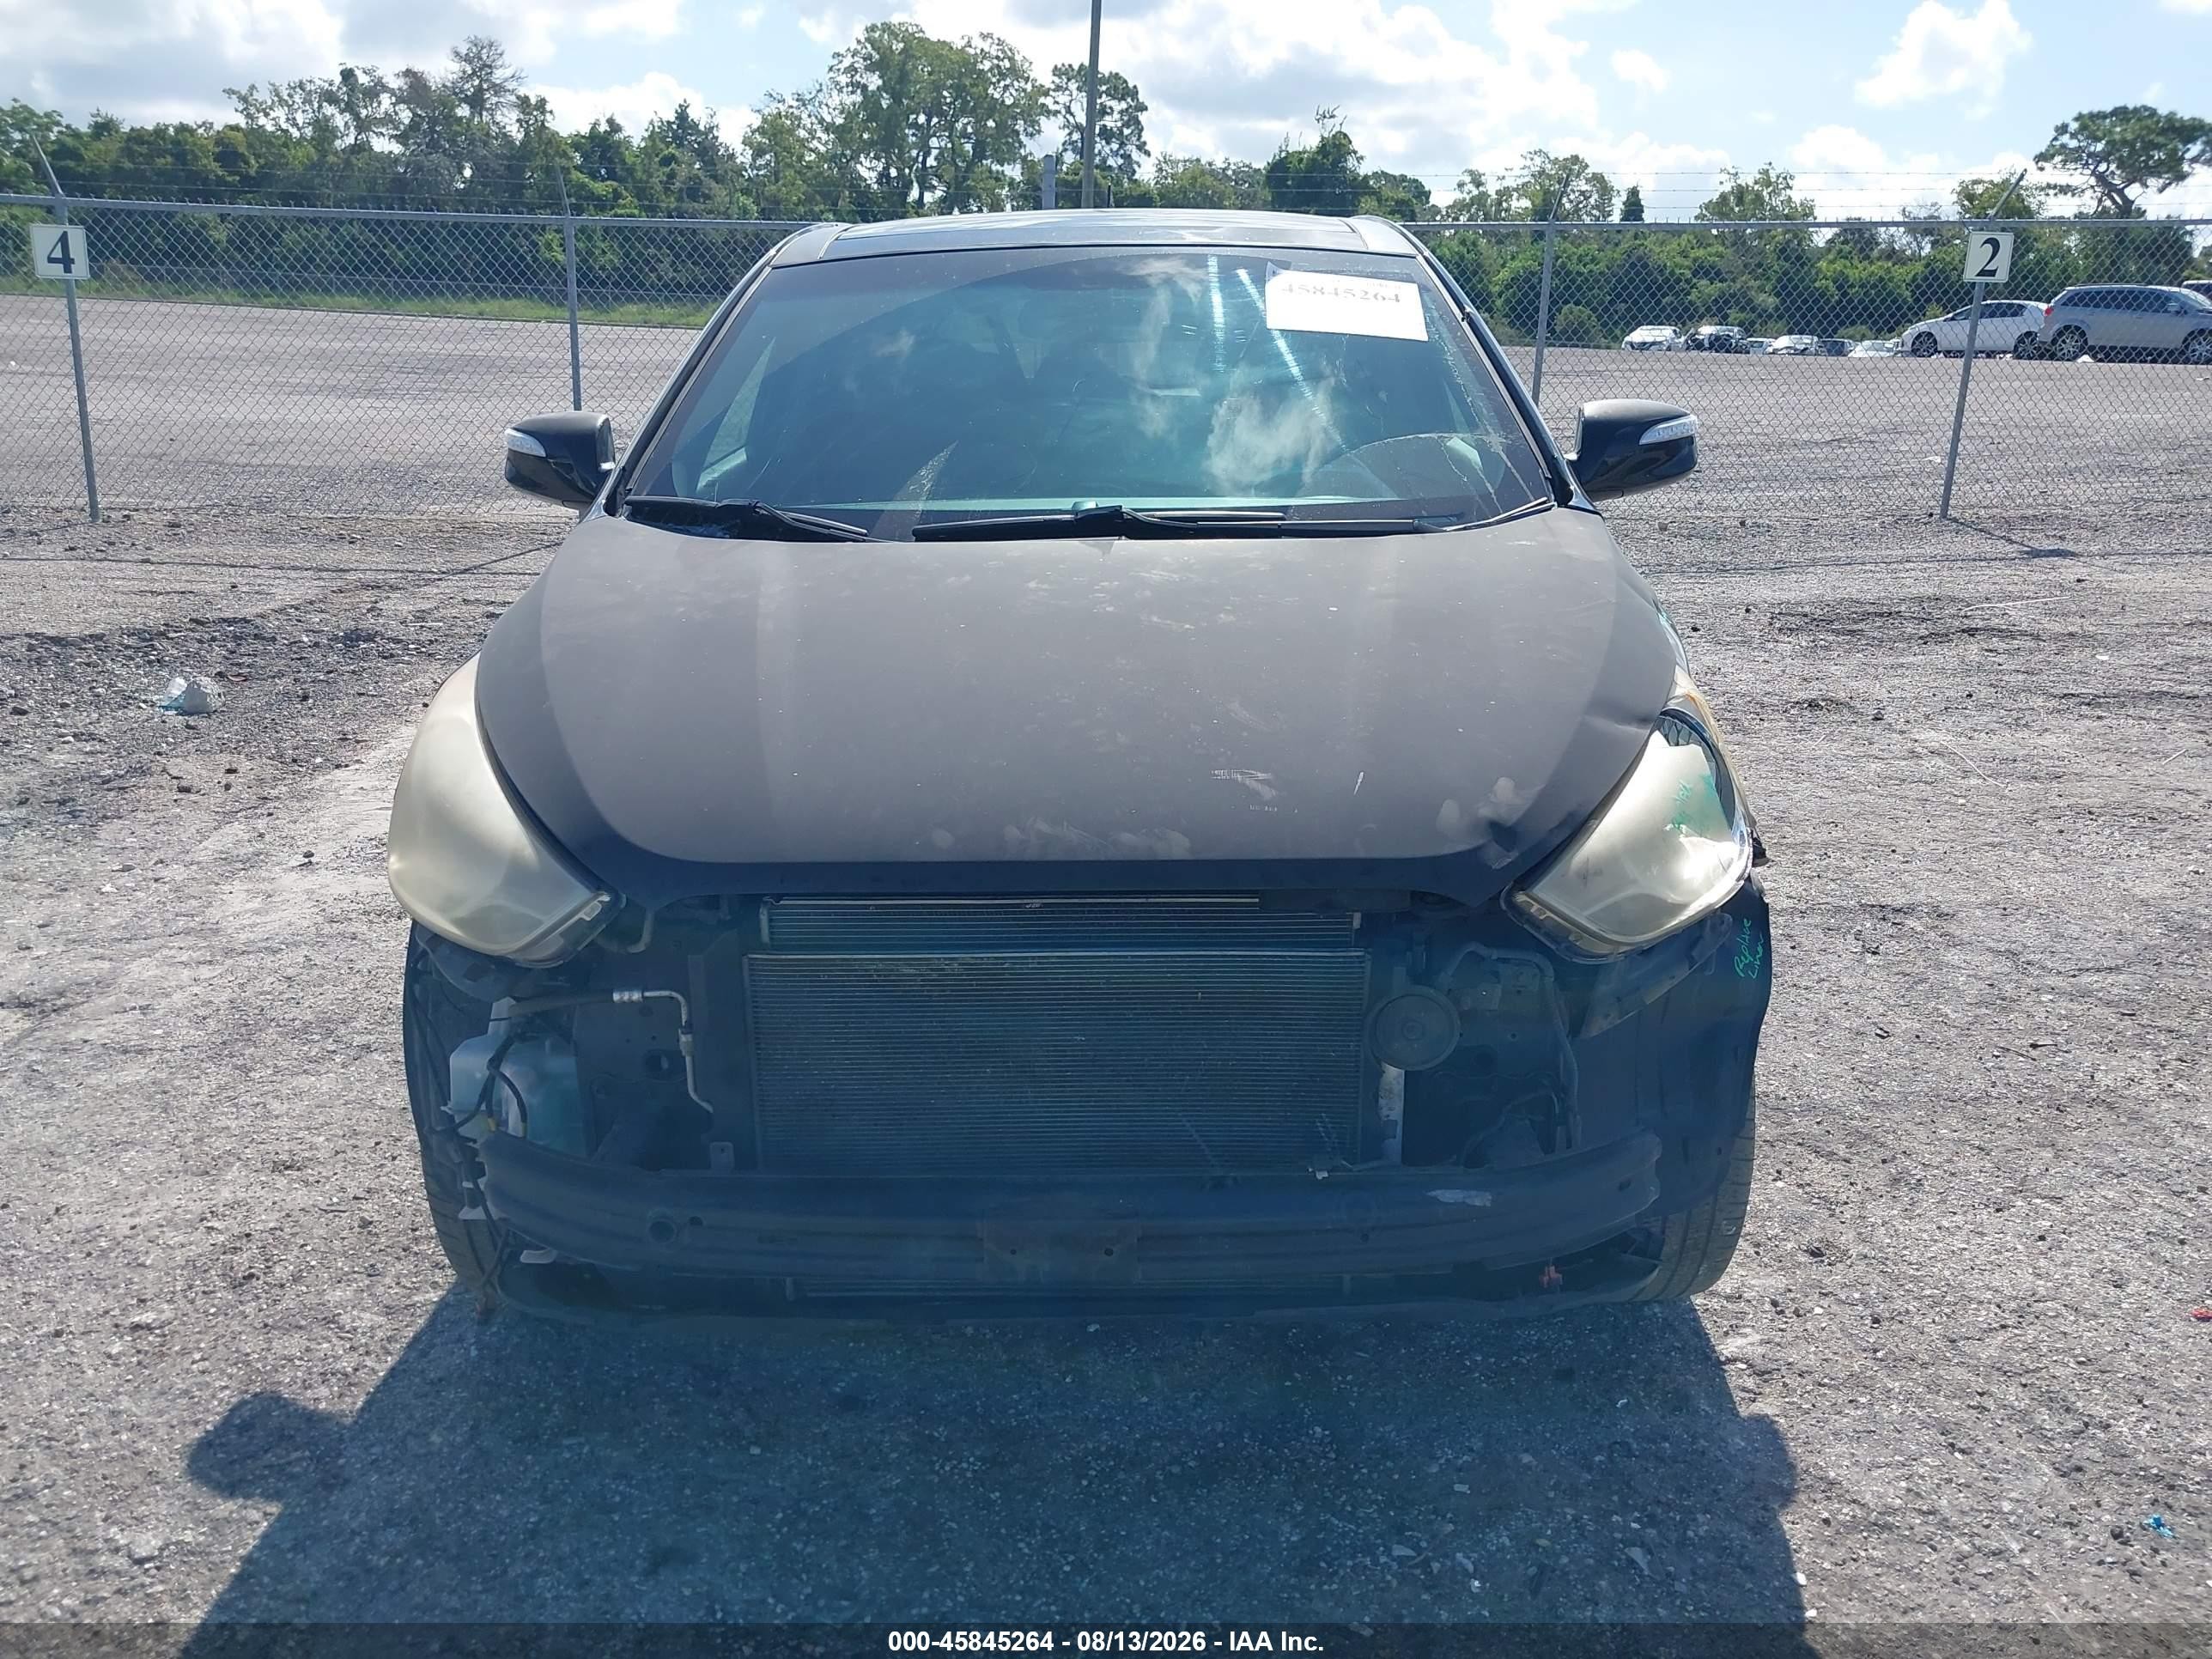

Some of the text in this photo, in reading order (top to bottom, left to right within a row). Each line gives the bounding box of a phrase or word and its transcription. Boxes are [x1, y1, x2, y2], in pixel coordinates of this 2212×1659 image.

[46, 230, 76, 274] 4
[1975, 236, 2001, 277] 2
[1280, 282, 1401, 304] 45845264
